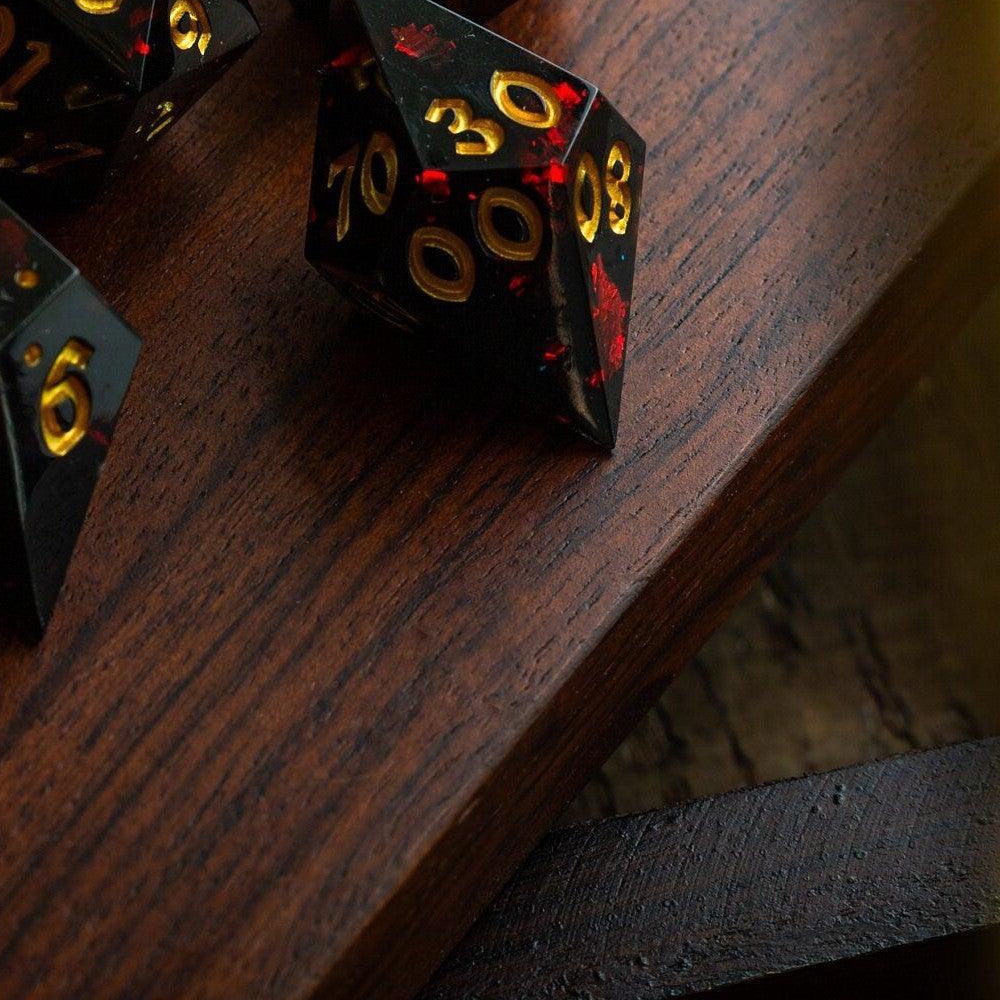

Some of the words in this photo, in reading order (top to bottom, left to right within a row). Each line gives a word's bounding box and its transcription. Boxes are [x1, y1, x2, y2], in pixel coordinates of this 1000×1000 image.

[424, 68, 562, 157] 30
[326, 130, 399, 243] 70
[408, 186, 544, 303] 00
